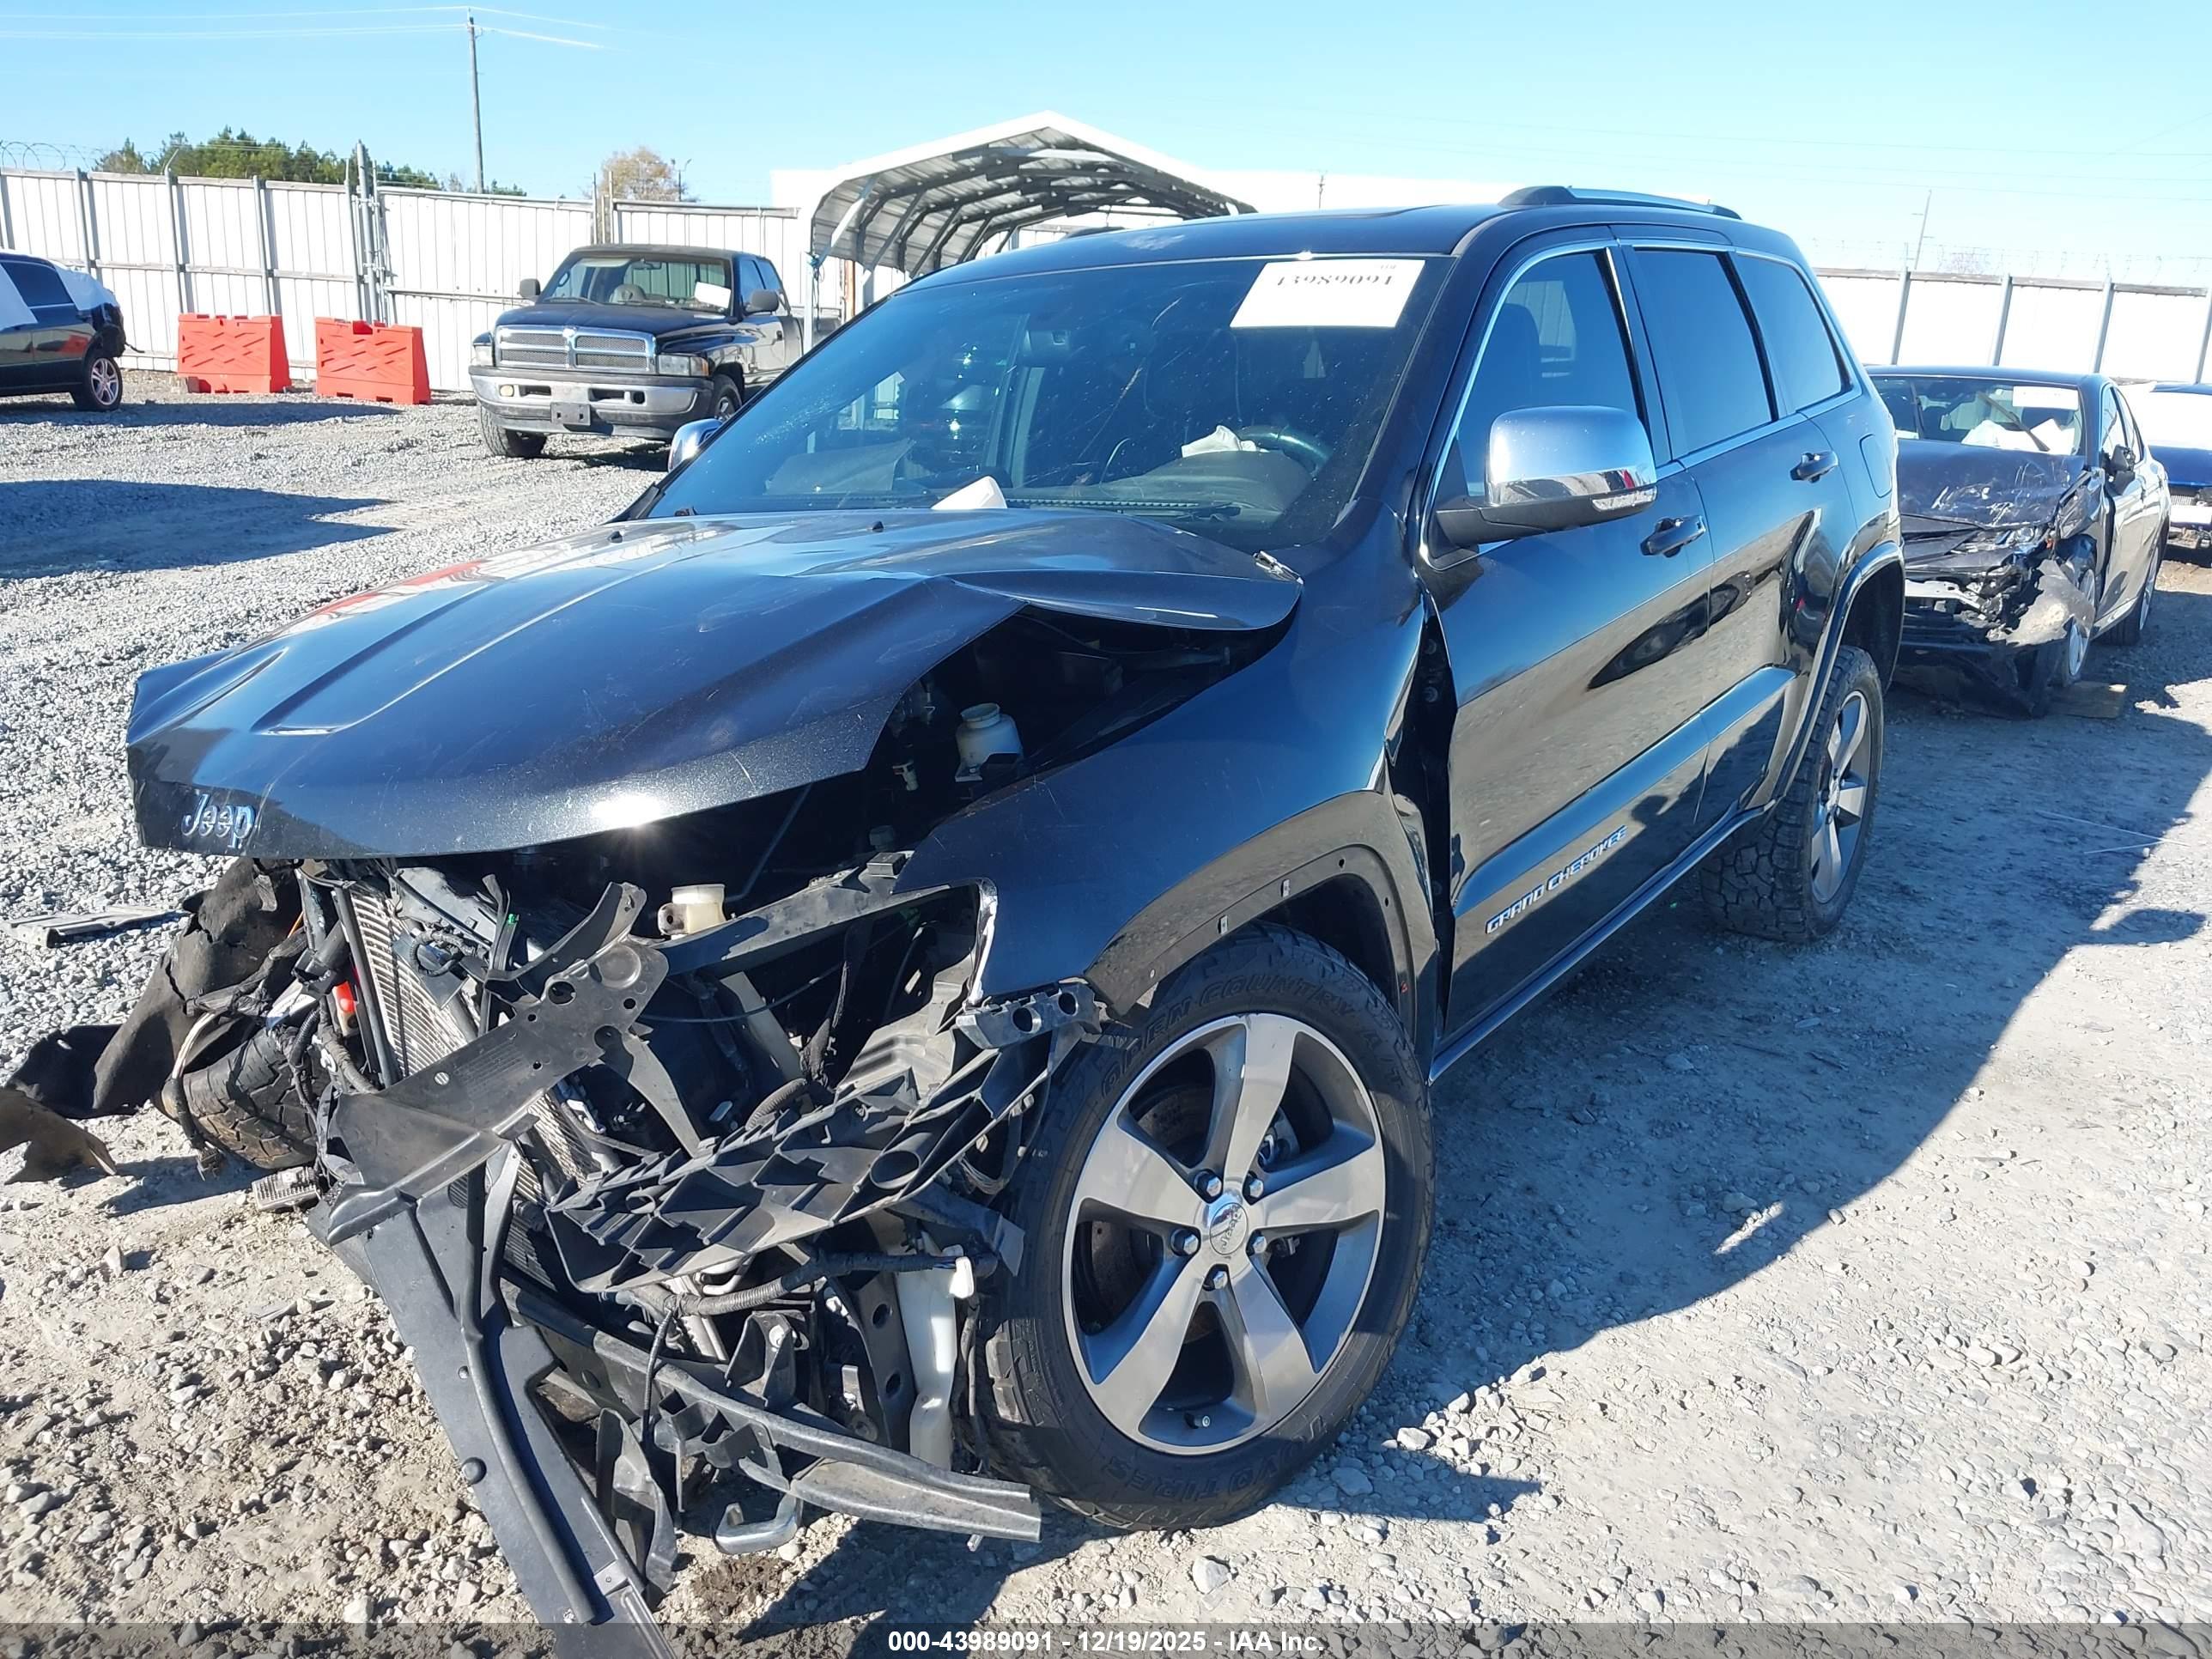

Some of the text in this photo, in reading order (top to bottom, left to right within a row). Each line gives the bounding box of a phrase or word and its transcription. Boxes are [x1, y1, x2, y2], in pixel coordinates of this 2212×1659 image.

[180, 793, 256, 848] Jeep
[1486, 824, 1628, 934] GRAND CHEROKEE
[1101, 996, 1193, 1100] OPEN
[1199, 973, 1356, 1018] COUNTRY
[1219, 1204, 1243, 1250] Jeep
[1102, 1455, 1222, 1503] TIRES
